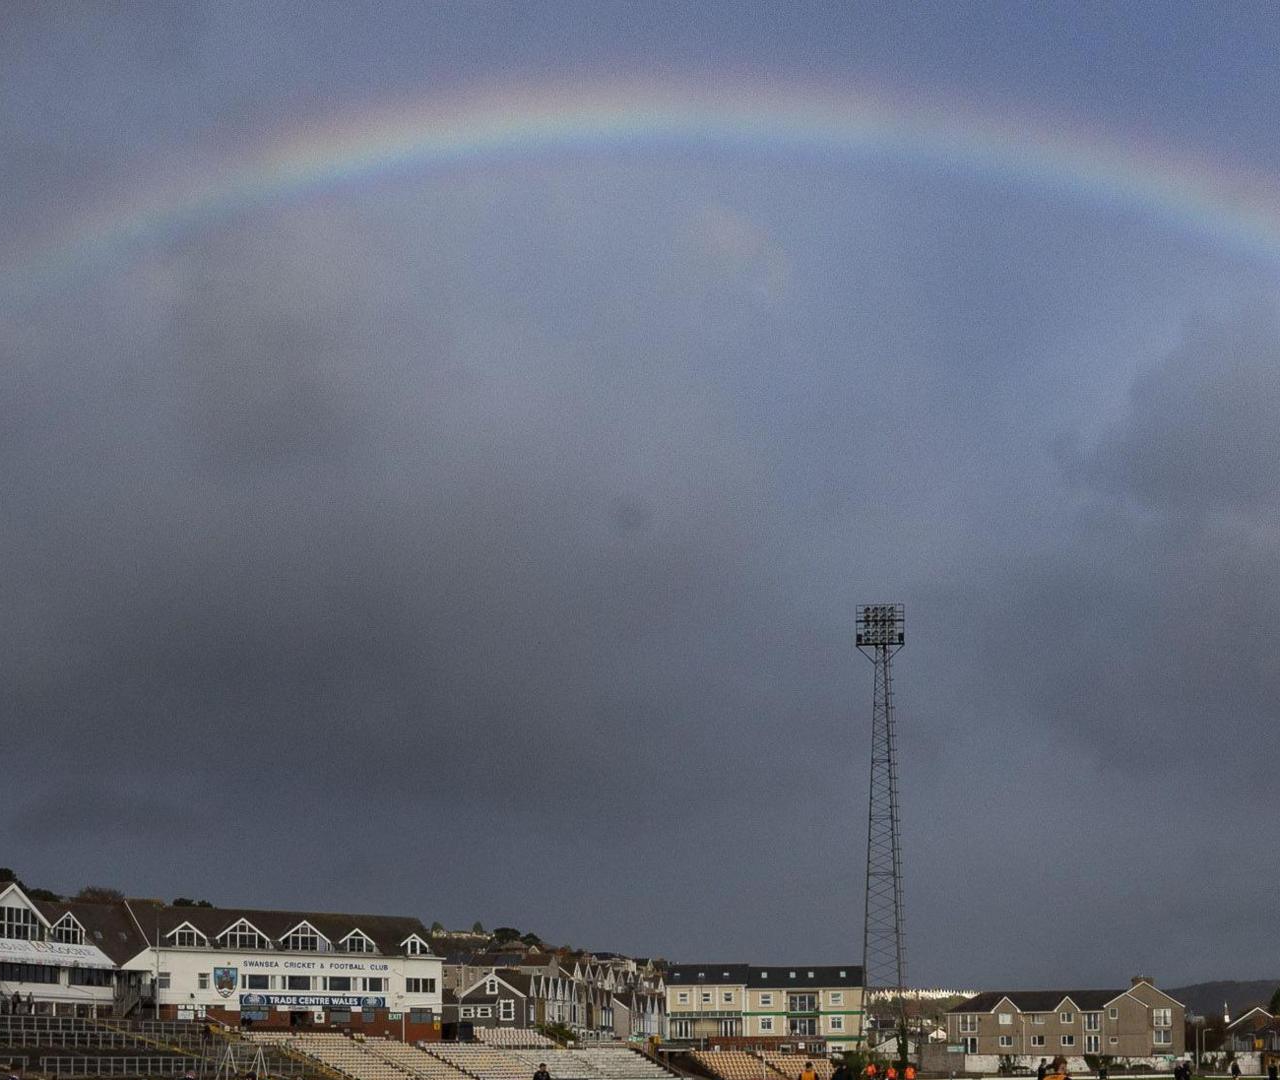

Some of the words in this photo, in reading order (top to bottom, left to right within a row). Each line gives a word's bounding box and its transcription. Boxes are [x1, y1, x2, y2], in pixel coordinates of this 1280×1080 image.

[269, 996, 297, 1004] TRADE
[298, 996, 329, 1005] CENTRE
[331, 997, 358, 1005] WALES
